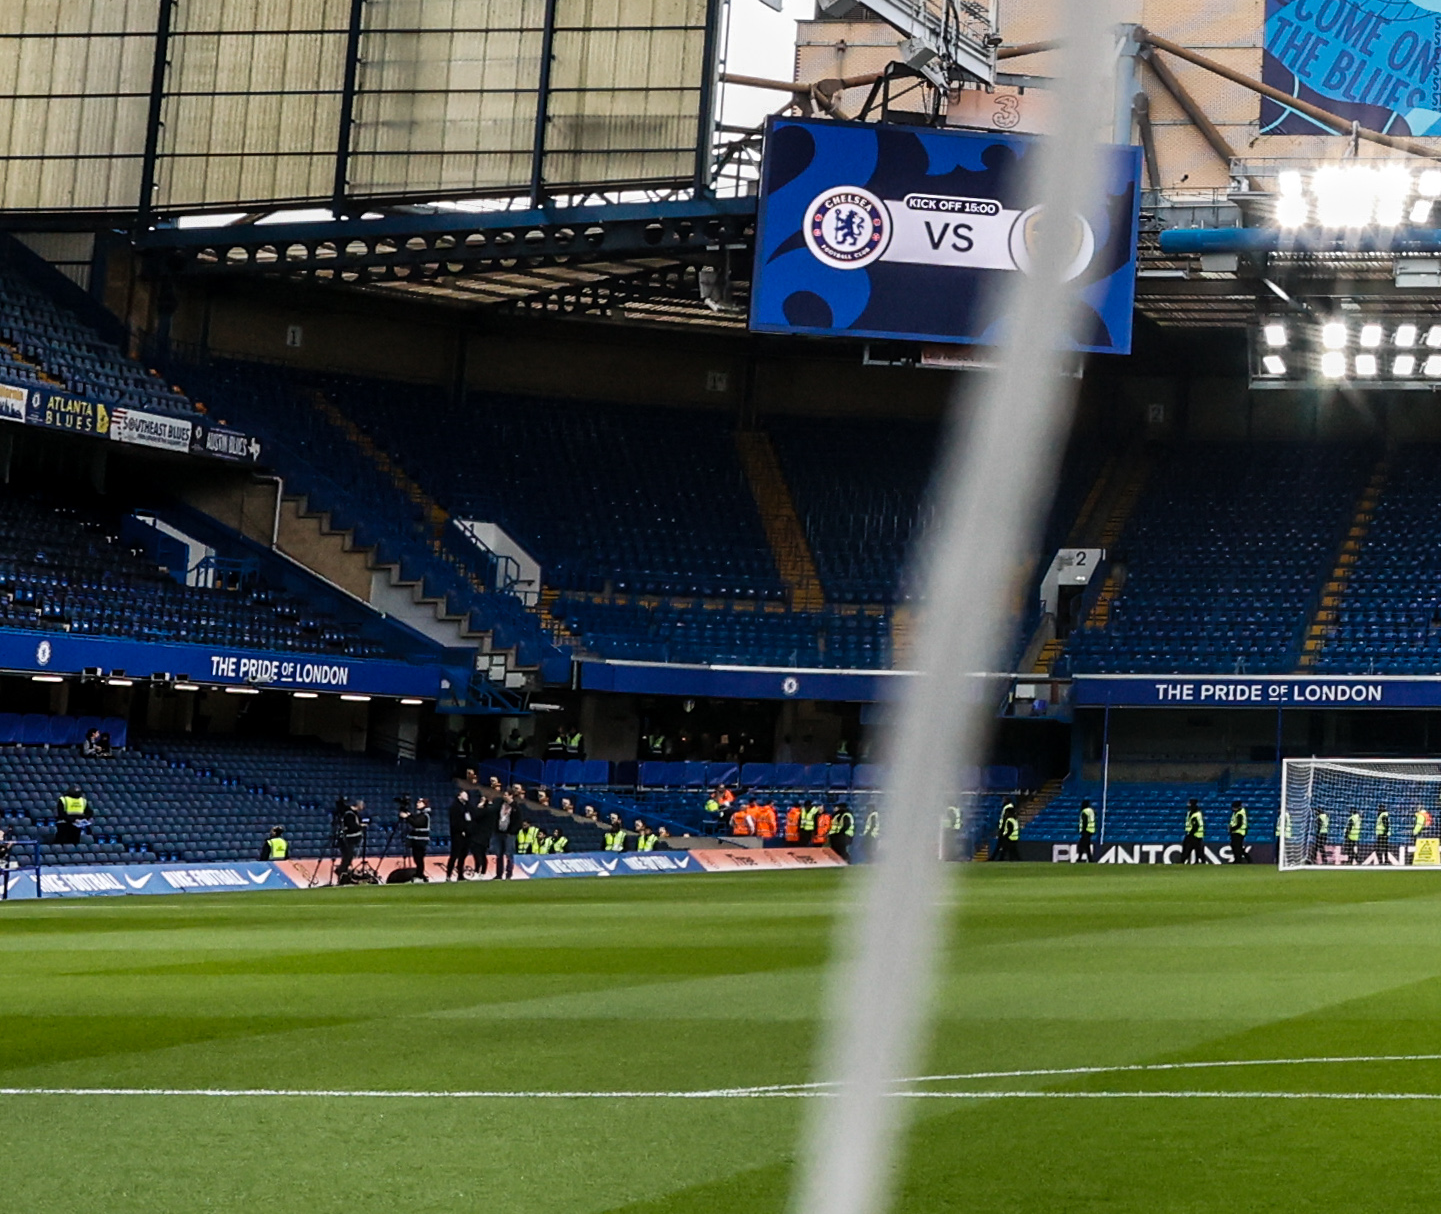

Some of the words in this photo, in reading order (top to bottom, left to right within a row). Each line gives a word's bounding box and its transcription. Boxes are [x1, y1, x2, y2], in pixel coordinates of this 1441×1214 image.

[1268, 16, 1329, 78] THE
[1388, 29, 1438, 85] ON
[825, 193, 873, 212] CHELSEA
[909, 198, 937, 210] KICK
[939, 202, 962, 212] OFF
[964, 202, 996, 214] 15:00
[924, 221, 974, 252] VS
[821, 244, 852, 260] FOOTBALL
[853, 247, 871, 259] CLUB
[47, 396, 93, 416] ATLANTA
[45, 411, 93, 432] BLUES
[122, 417, 167, 438] SOUTHEAST
[168, 425, 190, 441] BLUES
[1076, 551, 1086, 566] 2
[211, 656, 237, 677] THE
[239, 658, 279, 679] PRIDE
[281, 662, 294, 676] OF
[296, 664, 348, 685] LONDON
[1156, 684, 1194, 700] THE
[1201, 684, 1262, 701] PRIDE
[1268, 685, 1288, 697] OF
[1294, 684, 1382, 701] LONDON
